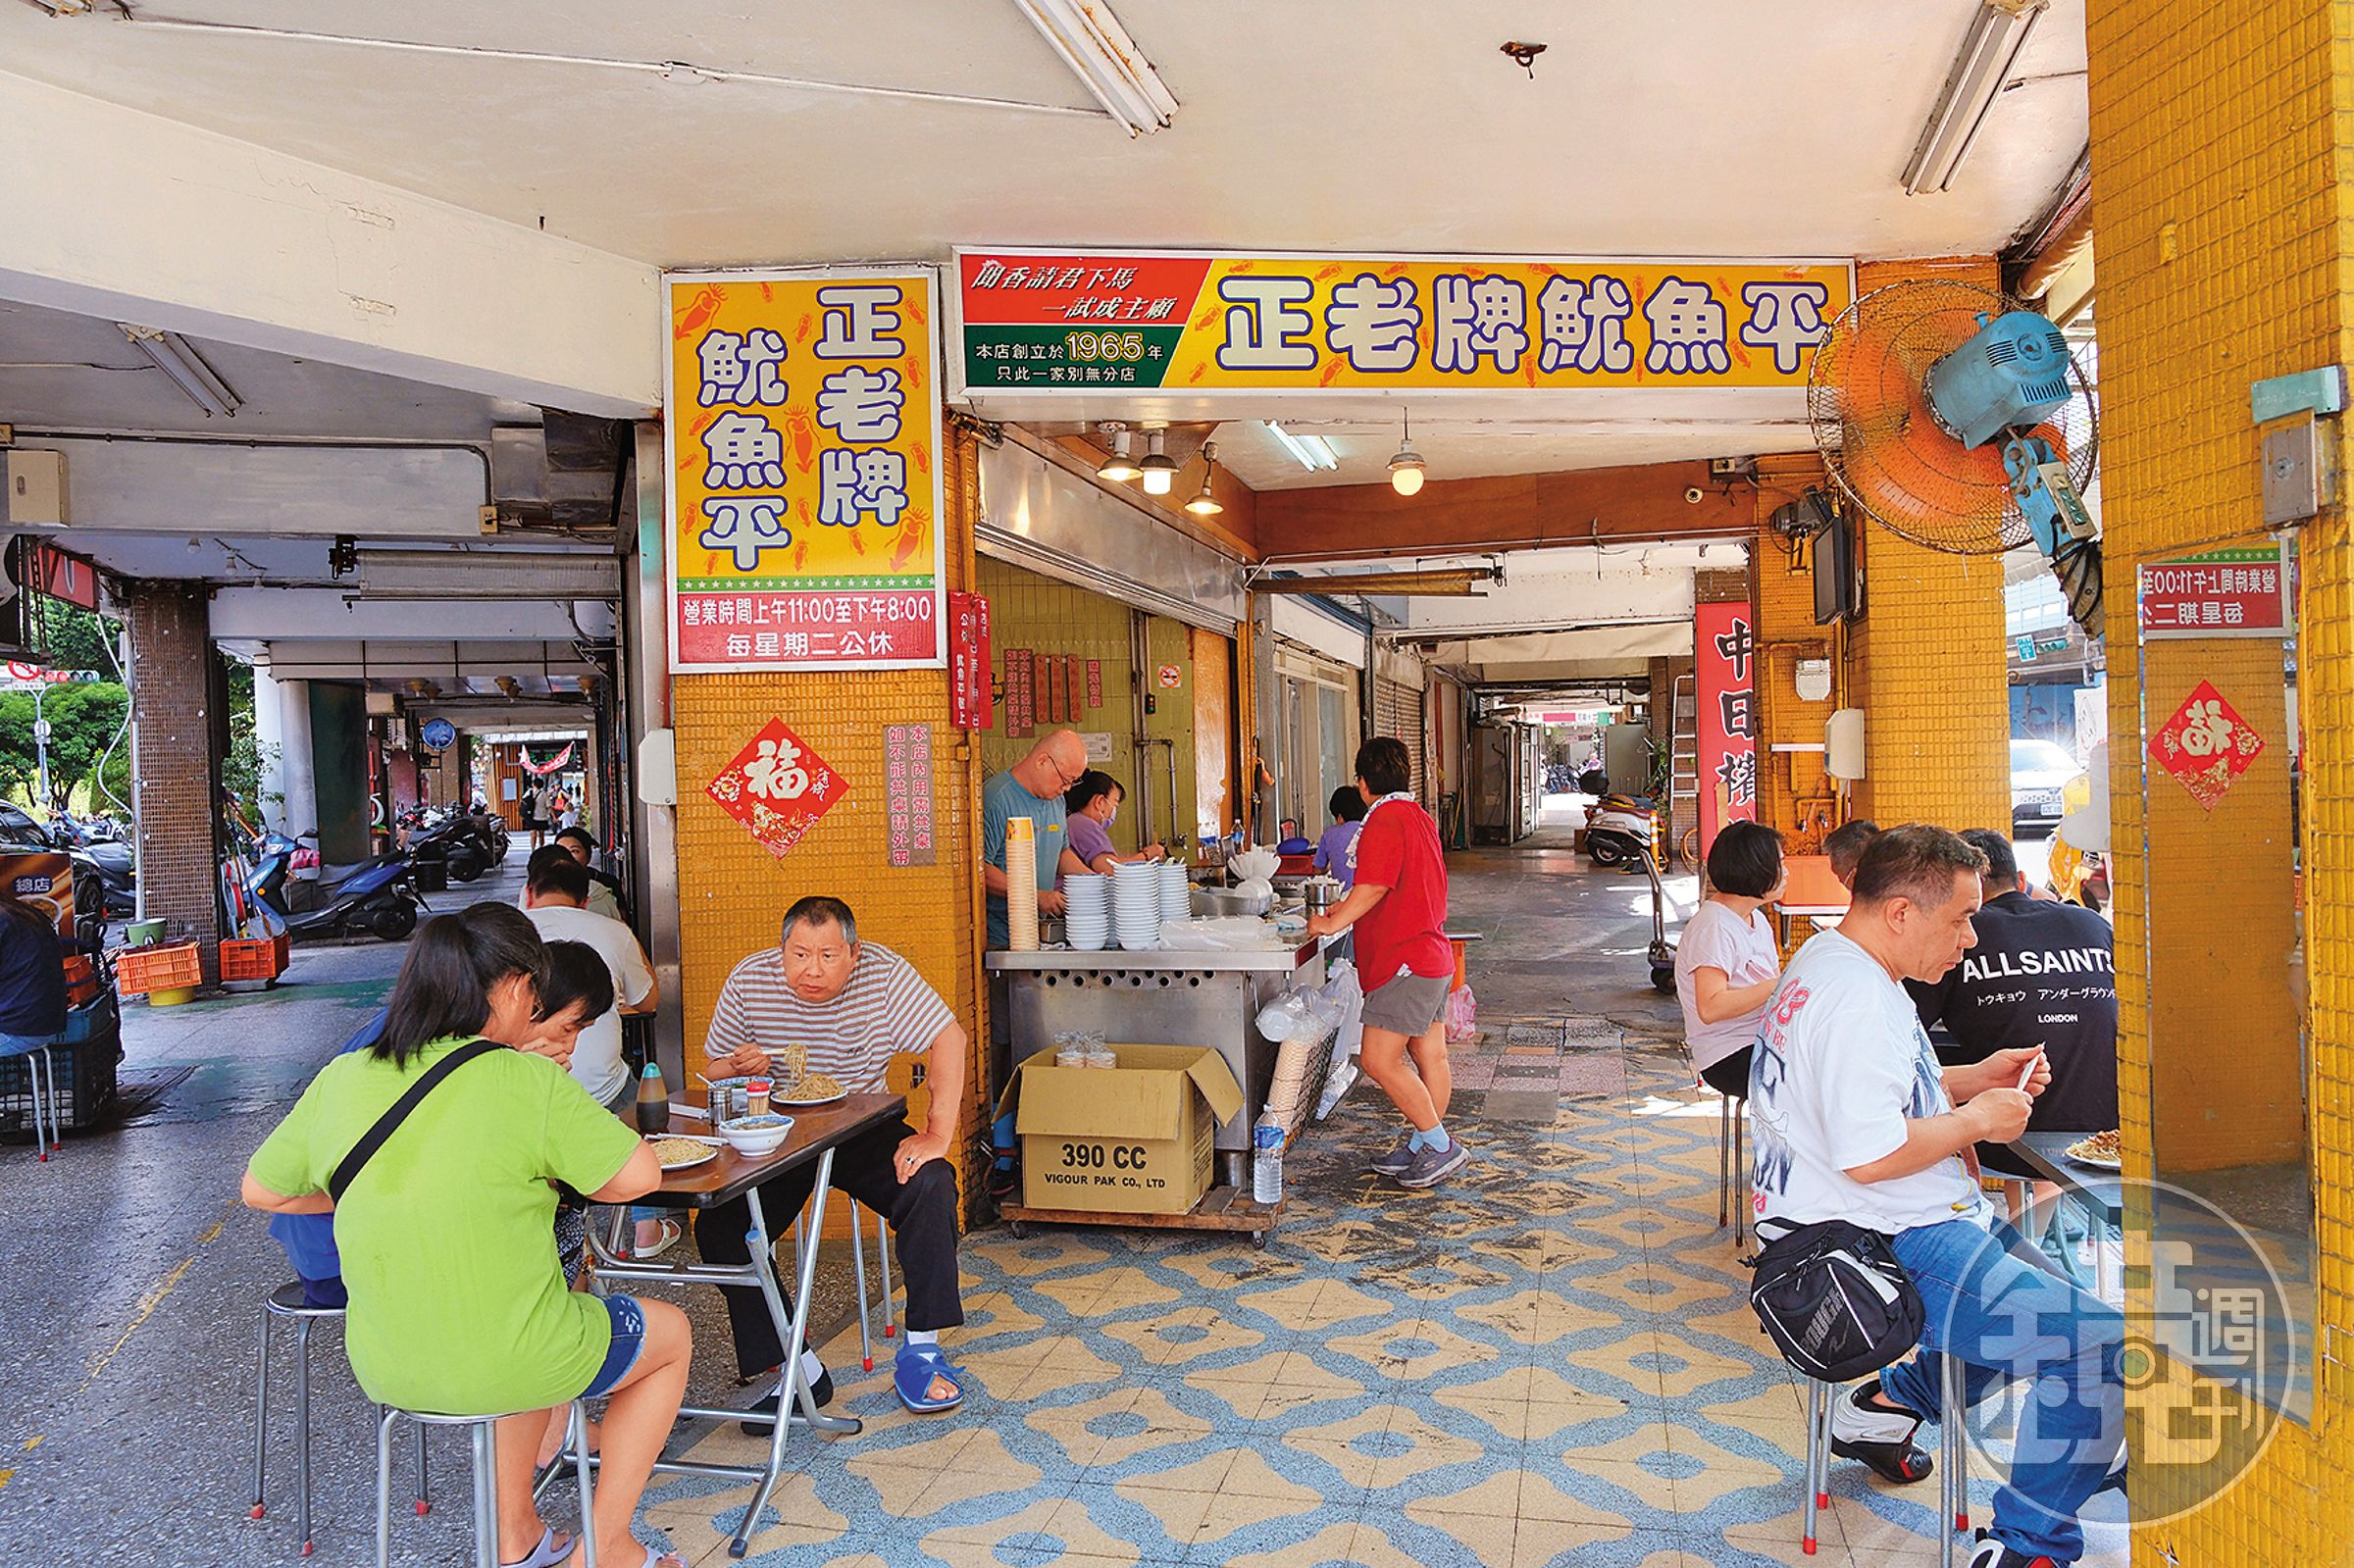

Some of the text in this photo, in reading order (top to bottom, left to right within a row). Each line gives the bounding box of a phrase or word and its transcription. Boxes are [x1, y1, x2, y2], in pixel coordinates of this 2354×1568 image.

[971, 262, 1139, 290] 聞香請君下馬
[1042, 296, 1178, 321] 一試成主顧
[1215, 274, 1832, 376] 正老牌魷魚平
[997, 366, 1137, 383] 只此一家別無分店
[813, 285, 909, 527] 正老牌
[695, 328, 793, 571] 魷魚平
[684, 596, 931, 626] 營業時間上午11:00至下午8:00
[726, 631, 894, 657] 每星期二公休
[1714, 617, 1756, 826] 中日檳
[743, 738, 809, 799] 福
[909, 726, 931, 849] 本店內用需共桌
[1976, 989, 2027, 1007] トウキョウ
[2037, 1013, 2078, 1024] LONDON
[1061, 1143, 1148, 1170] 390 CC
[1045, 1173, 1088, 1186] VIGOUR
[1094, 1177, 1116, 1187] PAK
[1147, 1179, 1166, 1189] LTD
